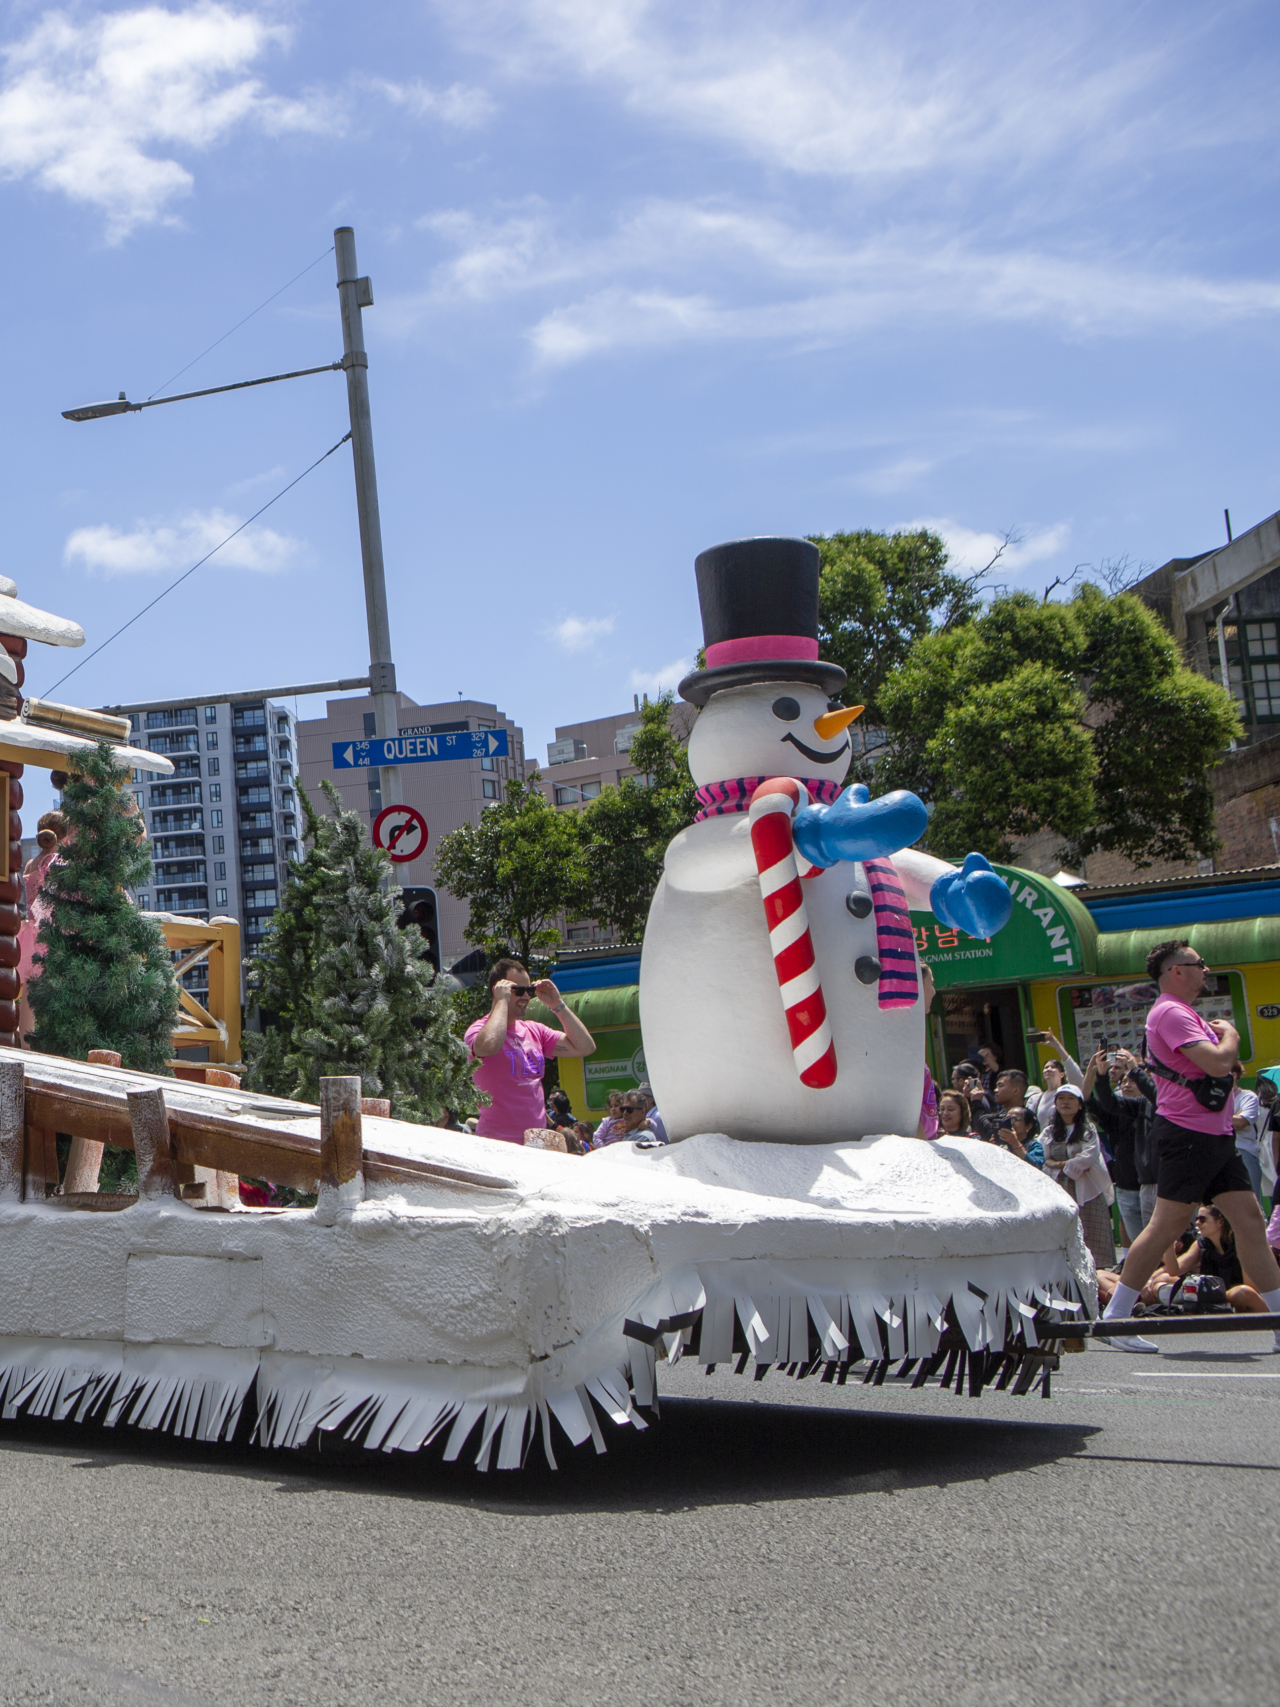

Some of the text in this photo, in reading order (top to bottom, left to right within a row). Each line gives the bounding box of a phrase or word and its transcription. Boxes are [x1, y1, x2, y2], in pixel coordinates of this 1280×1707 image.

[401, 726, 431, 736] GRAND
[471, 732, 485, 741] 329
[356, 741, 370, 750] 345
[383, 735, 457, 760] QUEEN ST
[472, 748, 486, 758] 267
[357, 757, 370, 766] 441
[1001, 874, 1074, 967] URANT
[913, 924, 991, 951] 강남
[920, 948, 993, 964] NGNAM STATION
[1263, 1007, 1278, 1017] 329
[588, 1064, 628, 1076] KANGNAM
